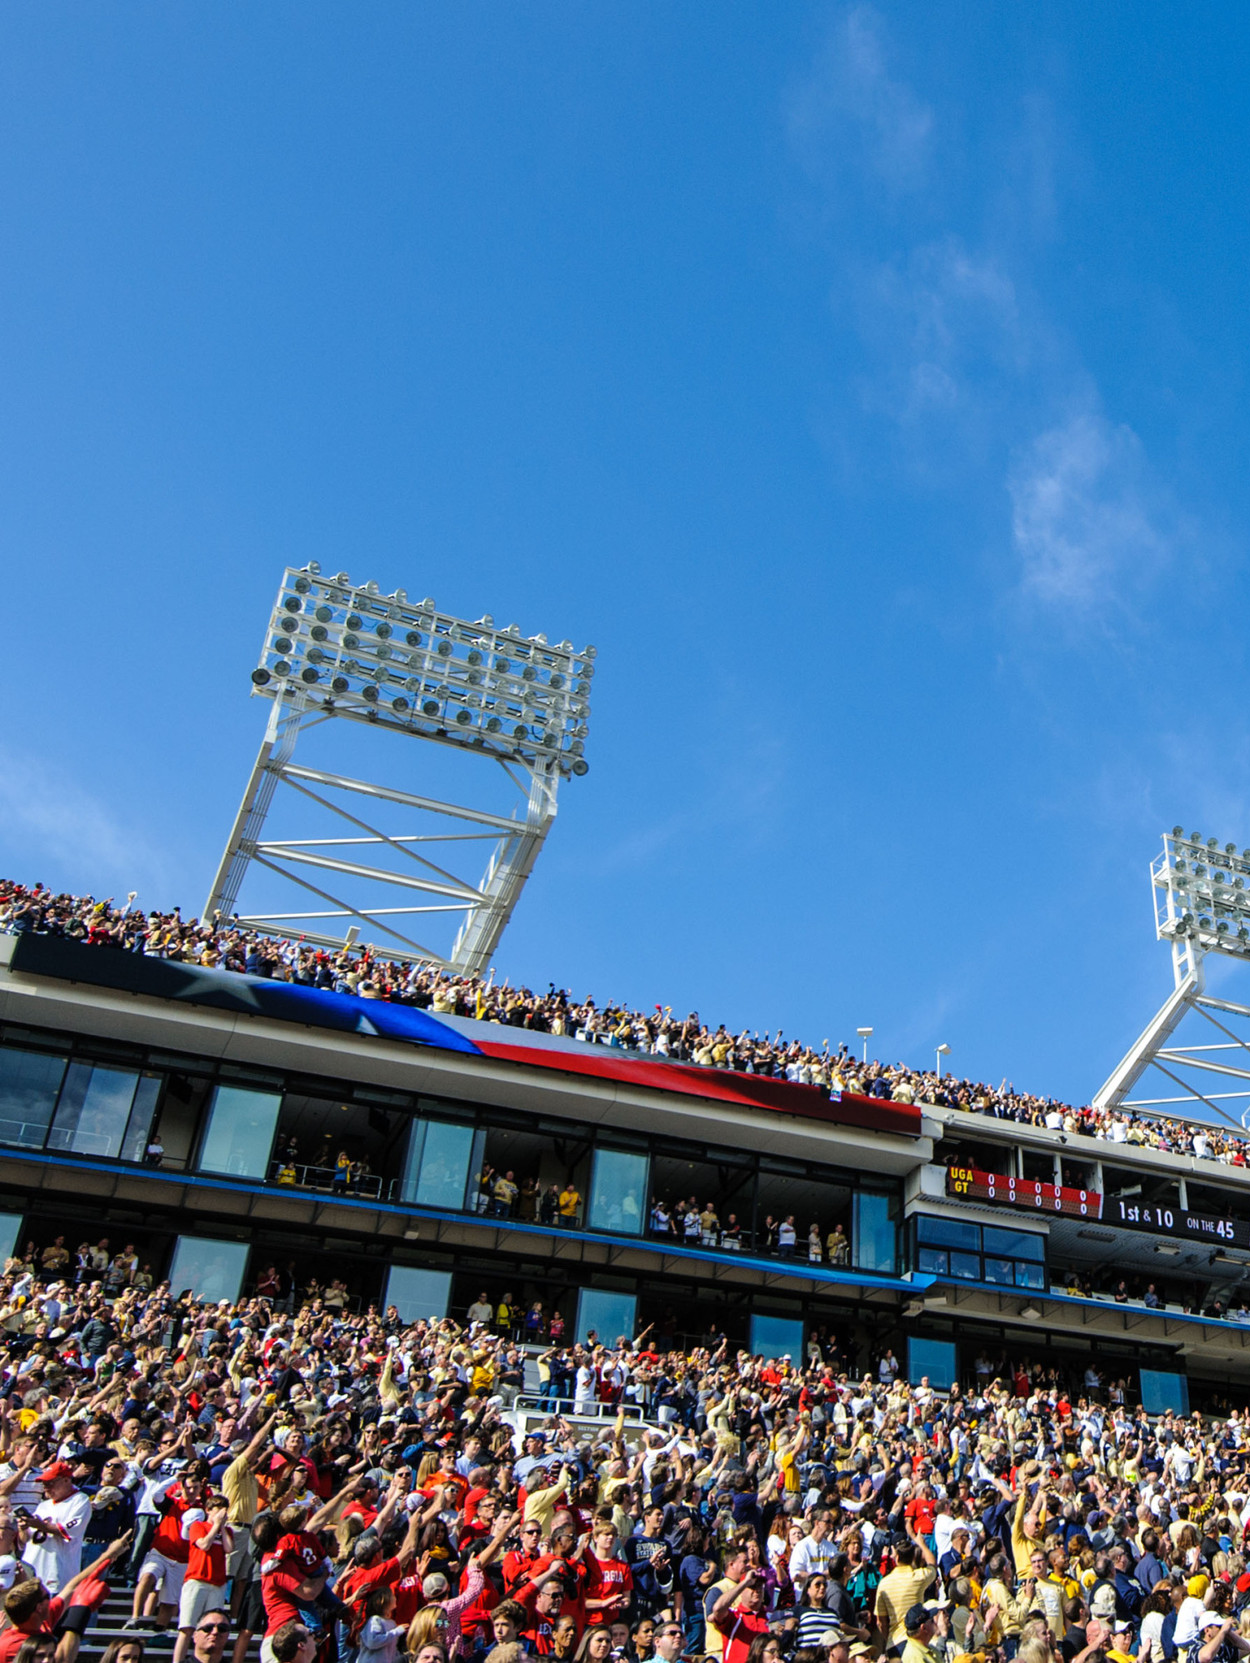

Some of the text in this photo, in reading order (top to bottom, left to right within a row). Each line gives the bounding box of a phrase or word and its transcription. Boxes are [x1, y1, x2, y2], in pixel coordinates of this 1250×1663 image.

[951, 1167, 1086, 1201] UGA 0 0 0 0 0
[955, 1181, 1087, 1215] GT 0 0 0 0 0
[1120, 1202, 1234, 1239] 1st & 10 ON THE 45
[603, 1570, 624, 1583] RGIA
